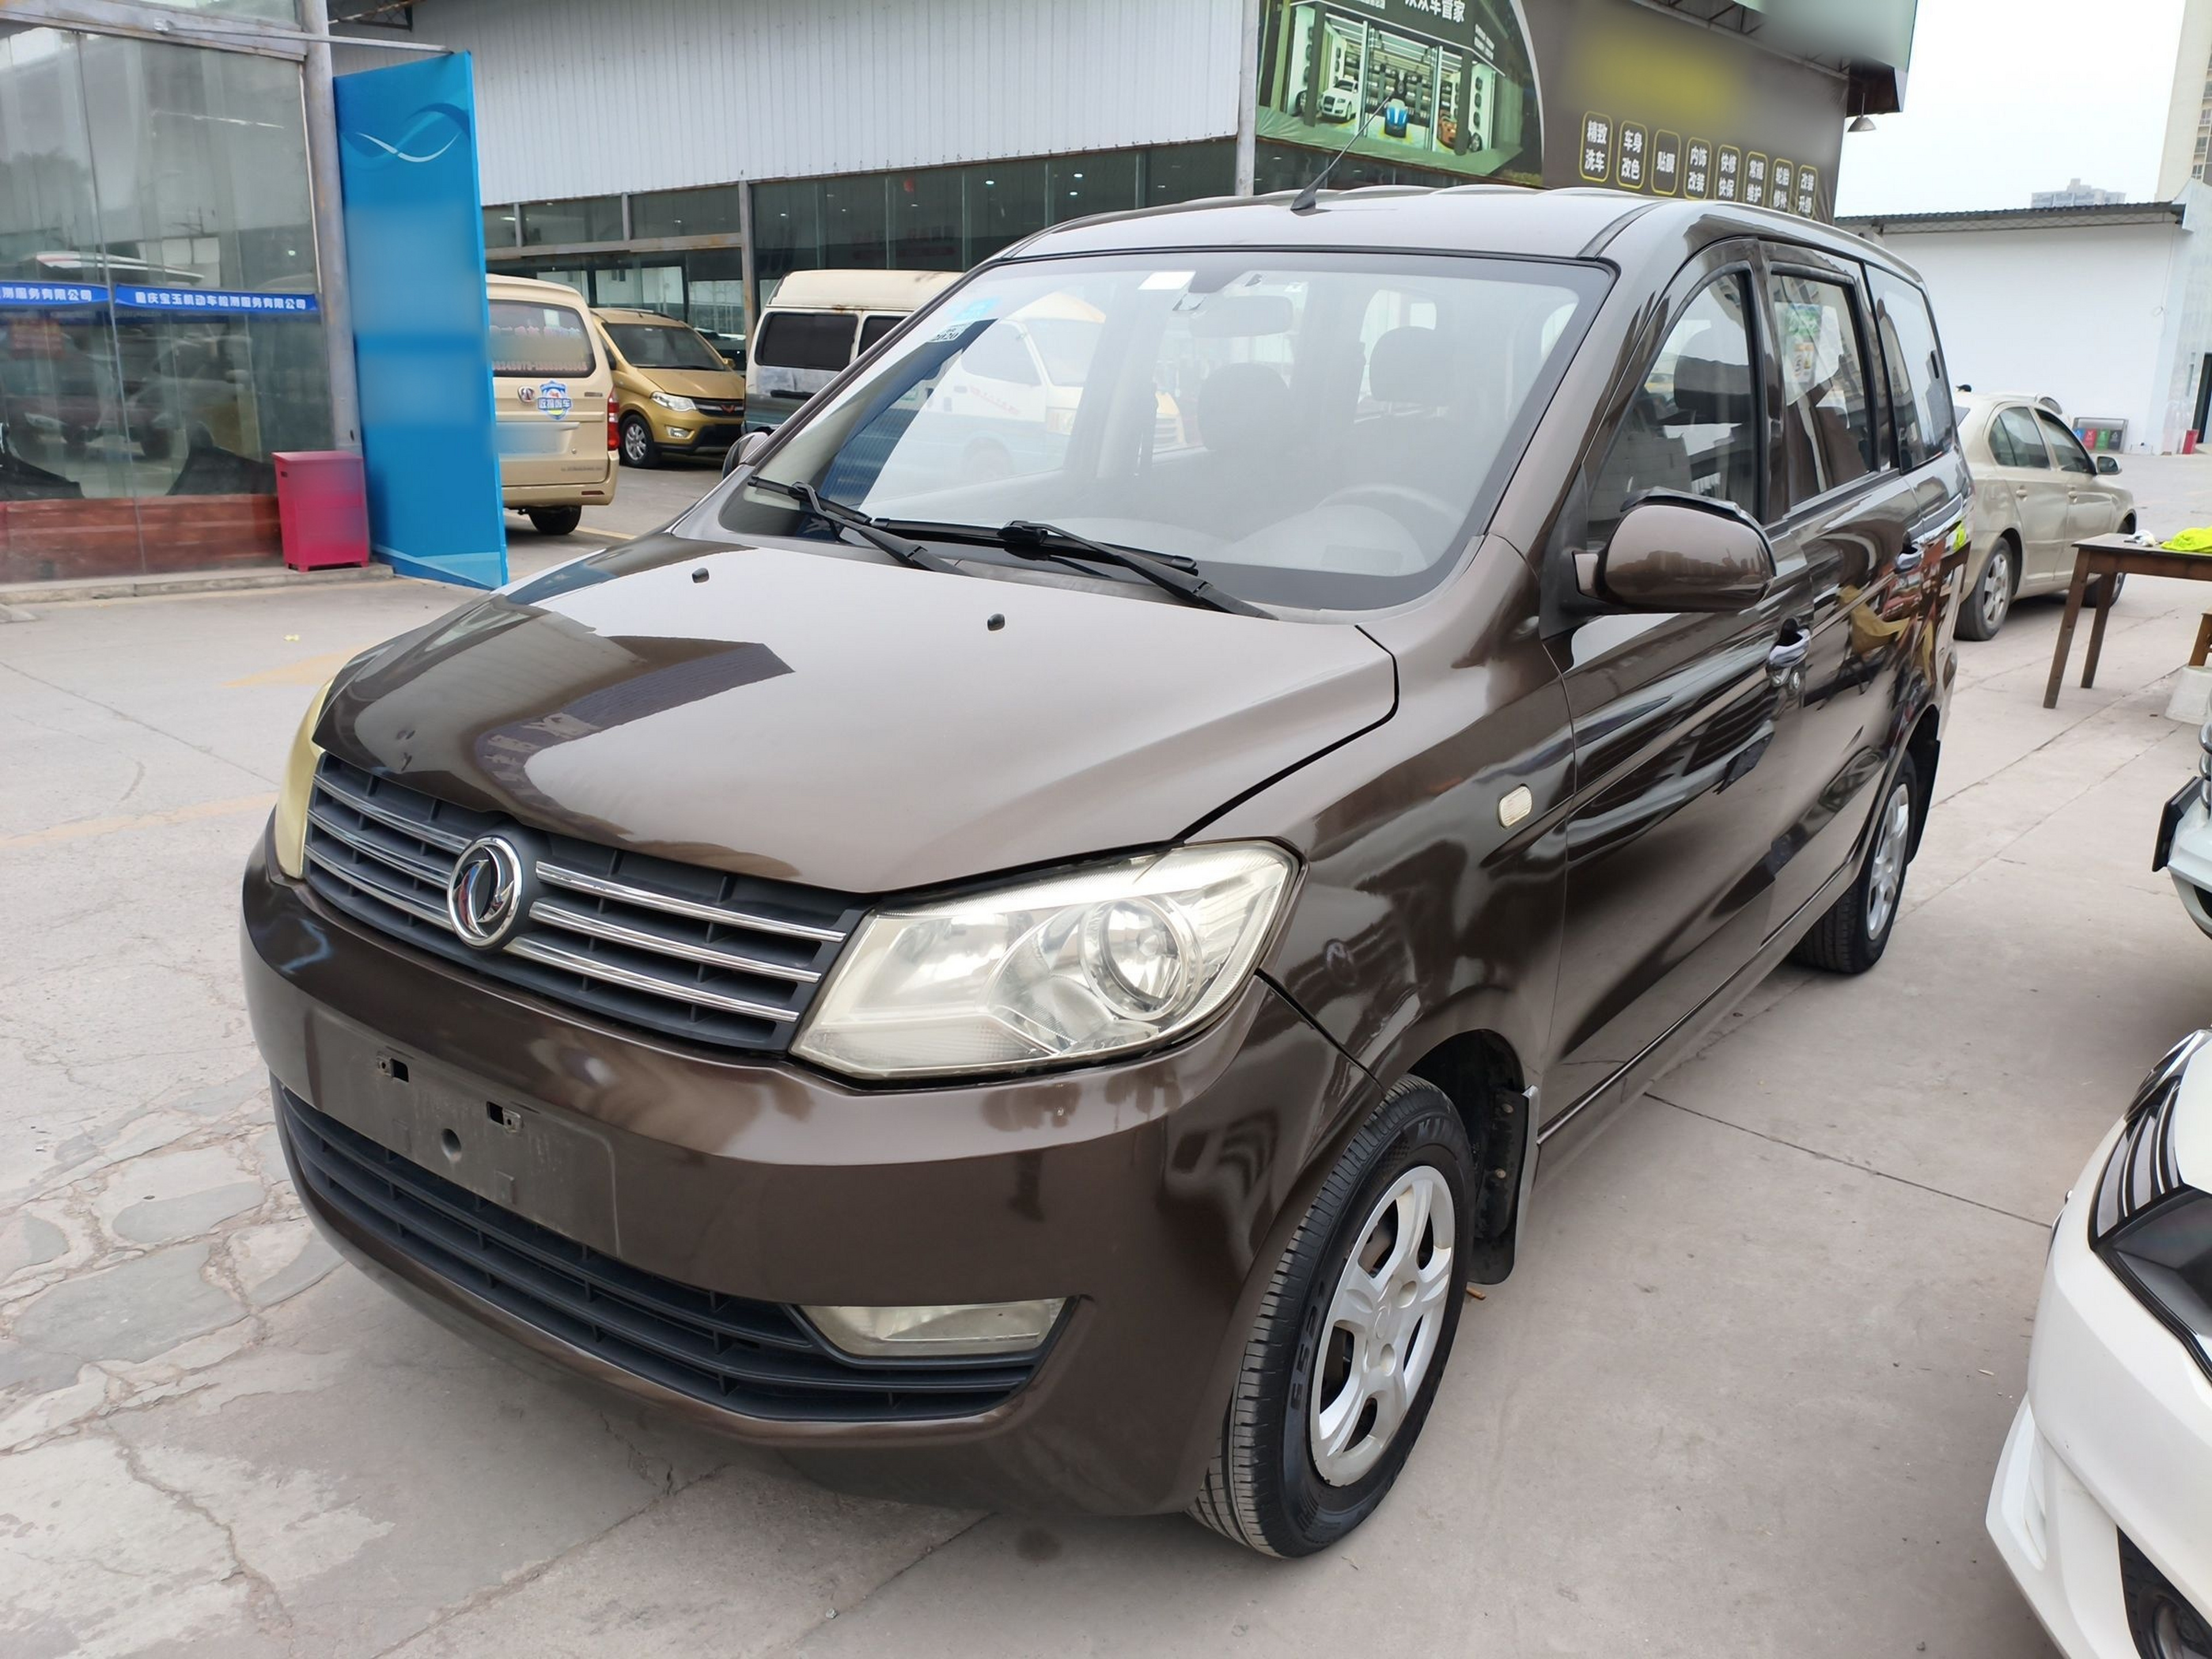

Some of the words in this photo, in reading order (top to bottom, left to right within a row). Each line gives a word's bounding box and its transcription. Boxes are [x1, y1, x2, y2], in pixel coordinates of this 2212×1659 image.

[1587, 120, 1608, 144] 精致
[1623, 129, 1642, 153] 车身
[1585, 149, 1605, 172] 洗车
[1656, 151, 1675, 173] 贴膜
[1690, 146, 1707, 168] 内饰
[1721, 152, 1737, 173] 快修
[1621, 157, 1640, 180] 改色
[1749, 160, 1764, 180] 常规
[1775, 166, 1790, 185] 轮胎
[1687, 171, 1705, 192] 改装
[1718, 176, 1734, 198] 快保
[1800, 172, 1815, 191] 改装
[1747, 183, 1762, 202] 维护
[1798, 195, 1812, 213] 升级
[0, 287, 92, 301] 测服务有限公司
